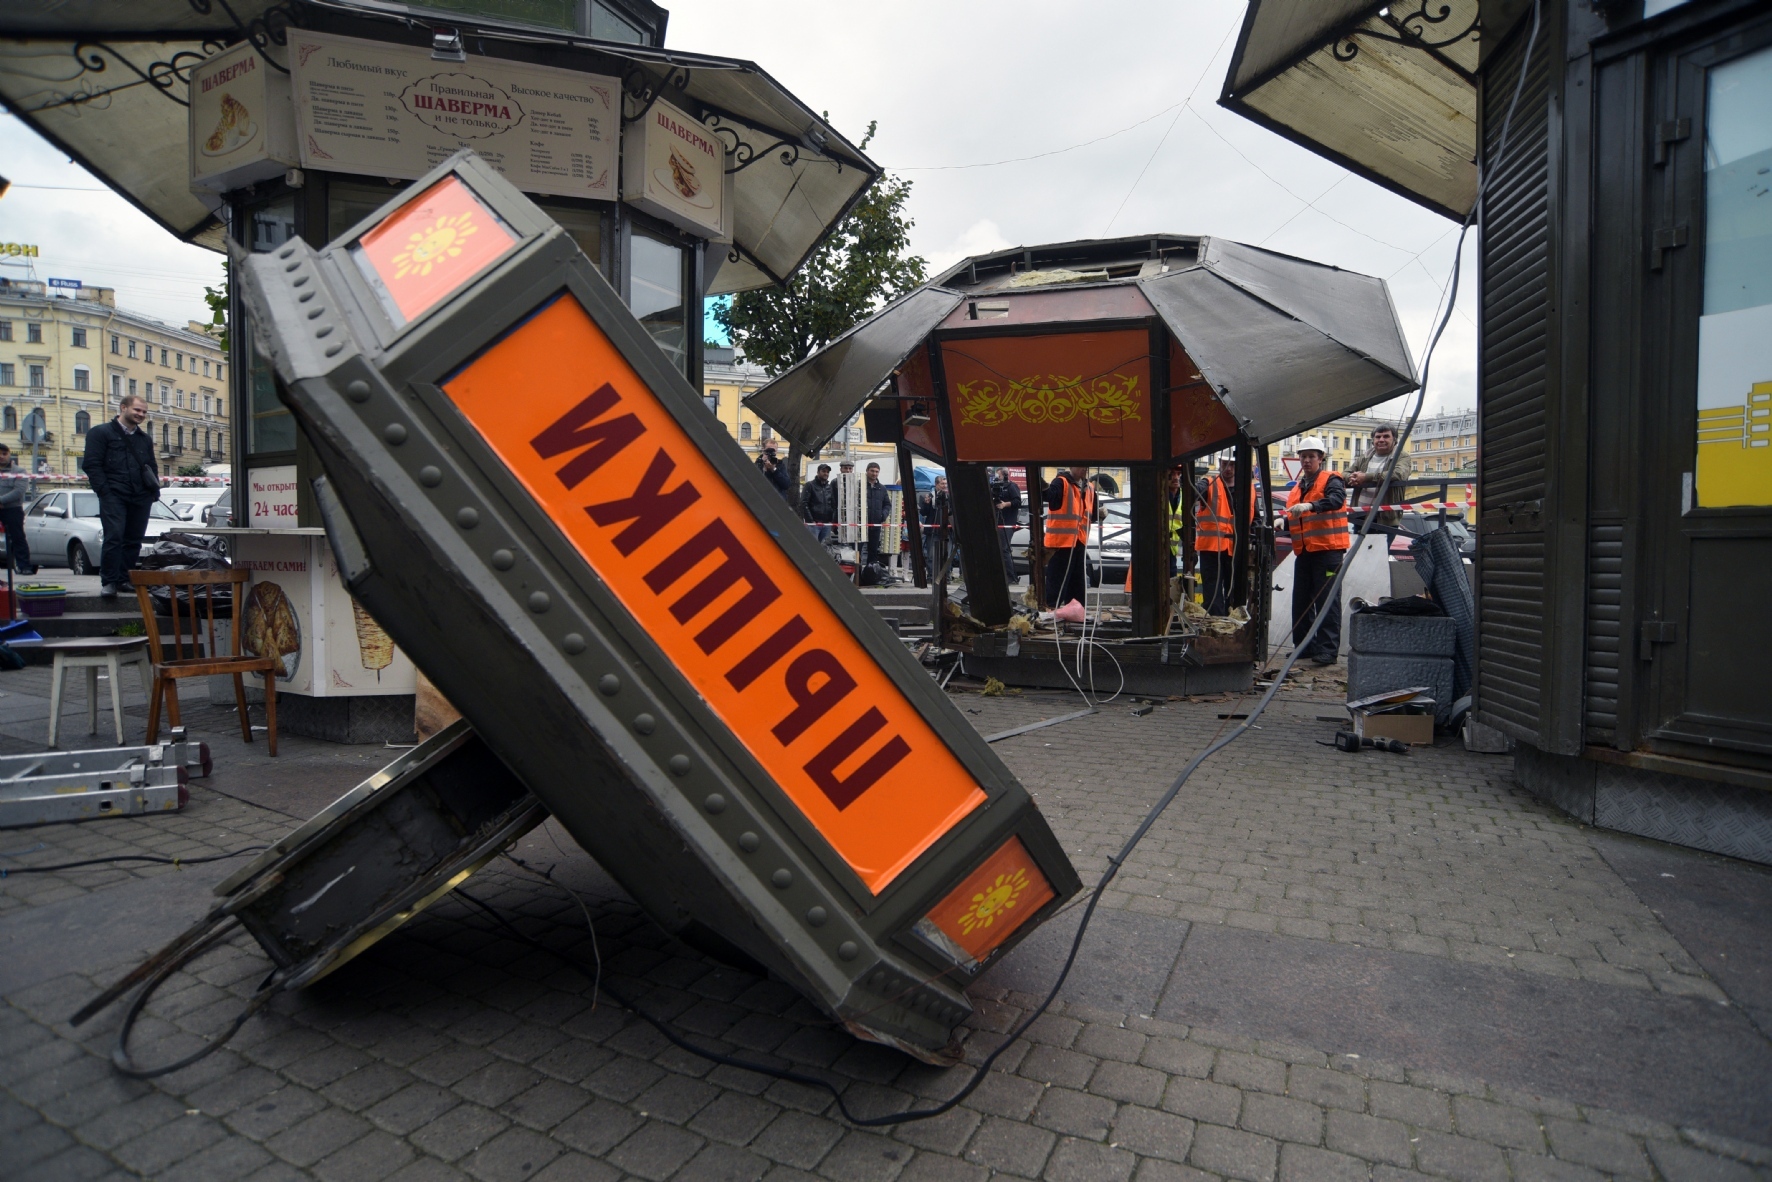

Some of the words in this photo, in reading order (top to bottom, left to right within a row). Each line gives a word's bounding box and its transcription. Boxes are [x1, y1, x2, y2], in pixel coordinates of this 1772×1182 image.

[202, 56, 256, 94] ШАВЕРМА
[328, 57, 382, 74] Любимый
[385, 67, 408, 79] вкус
[430, 83, 495, 100] Правильная
[511, 84, 552, 98] Высокое
[554, 92, 594, 104] качество
[414, 94, 512, 120] ШАВЕРМА
[445, 116, 458, 124] не
[657, 112, 714, 157] ШАВЕРМА
[253, 483, 265, 492] Мы
[267, 483, 297, 493] открыт
[254, 501, 269, 516] 24
[276, 561, 306, 572] САМИ!
[530, 383, 911, 811] ПЫШКИ
